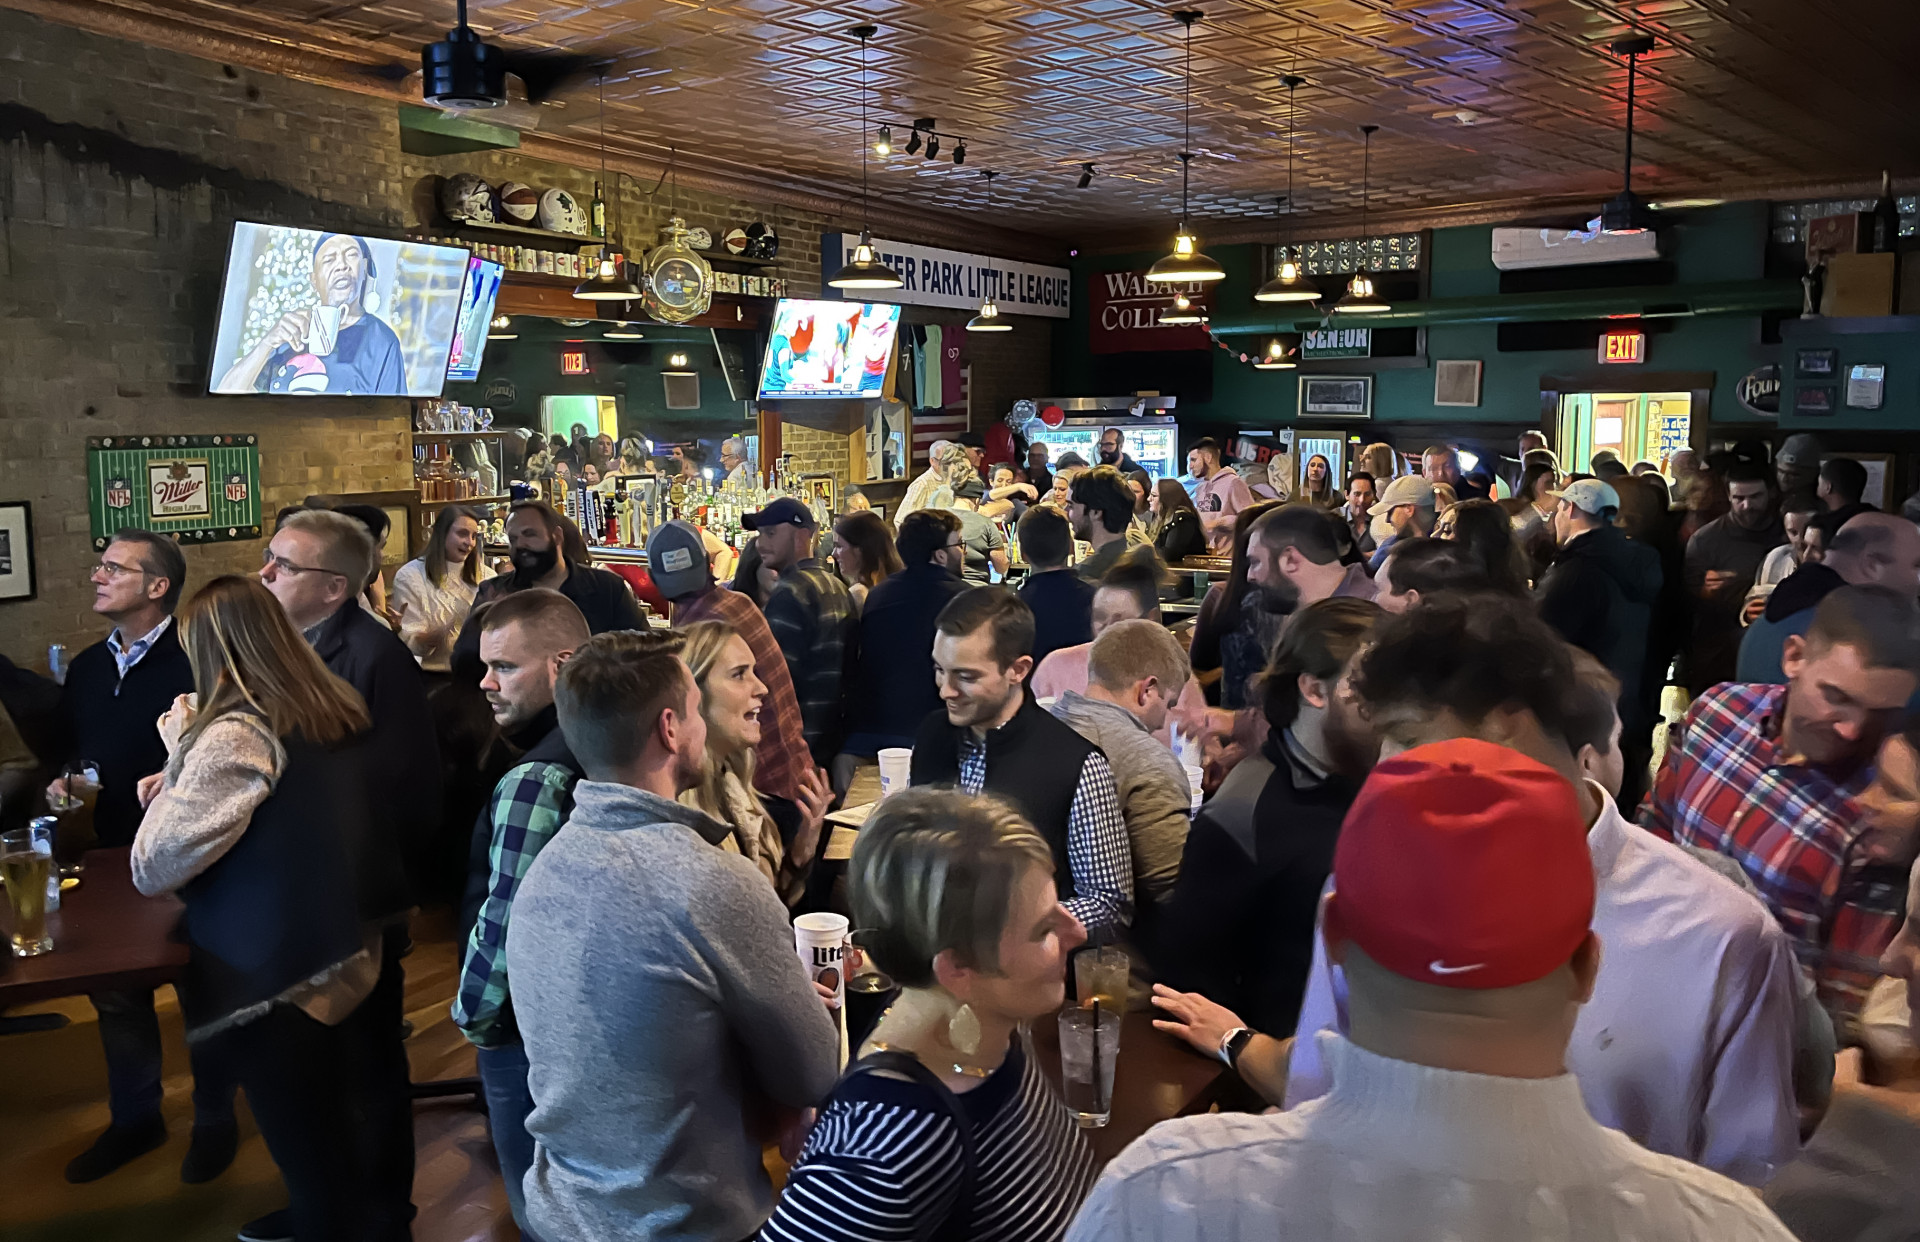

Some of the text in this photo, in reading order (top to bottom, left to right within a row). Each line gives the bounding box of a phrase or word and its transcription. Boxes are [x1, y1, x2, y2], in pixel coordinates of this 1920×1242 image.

[922, 259, 964, 297] PARK
[968, 267, 1015, 302] LITTLE
[1020, 272, 1068, 307] LEAGUE
[1102, 305, 1207, 331] COLL
[1606, 335, 1639, 360] EXIT
[1744, 373, 1781, 402] Foun
[108, 489, 130, 507] NFL
[154, 480, 204, 505] Miller
[226, 484, 246, 499] NFL
[162, 503, 203, 513] HIGH LIFE
